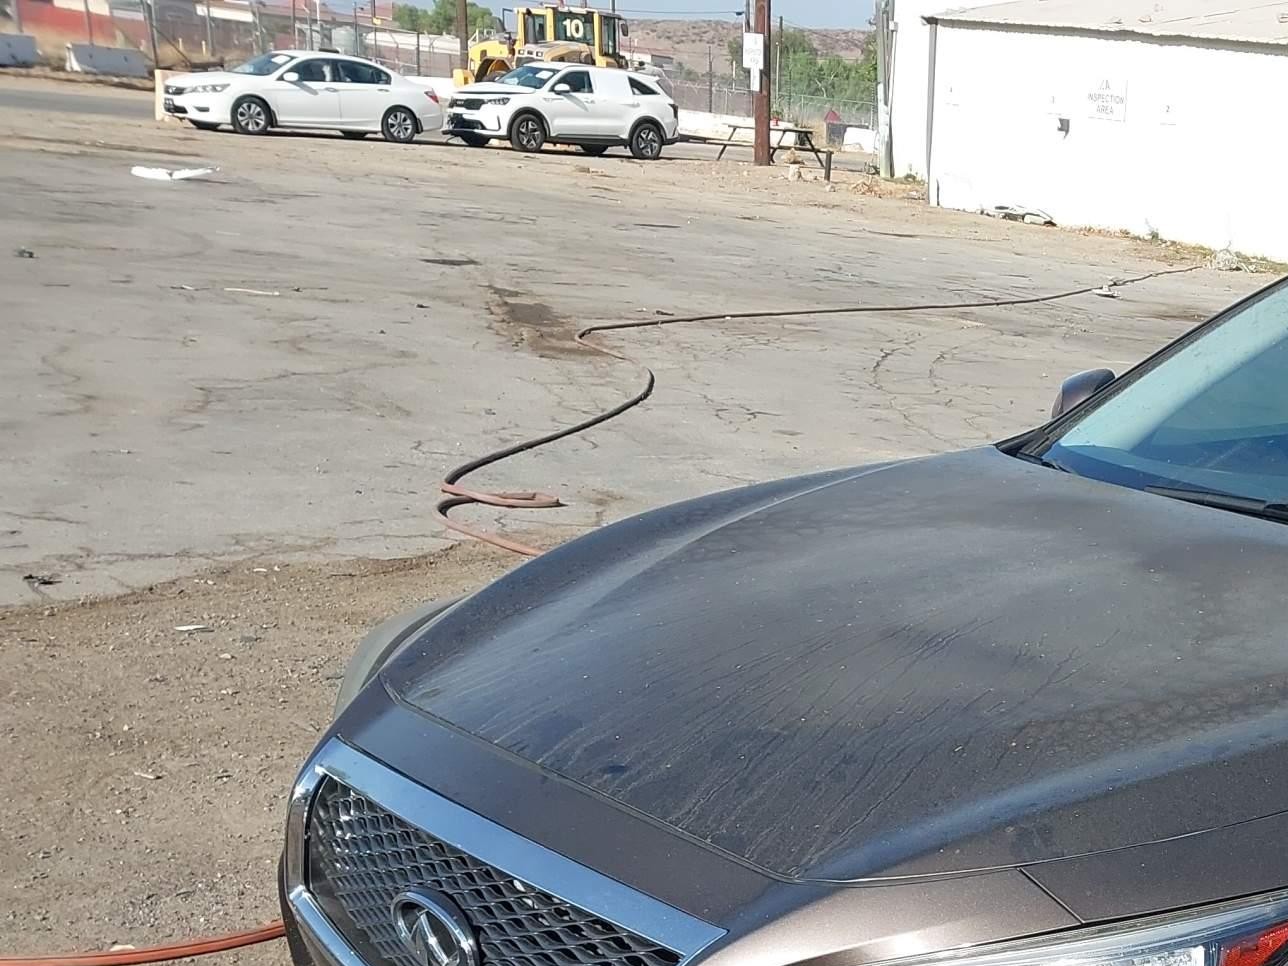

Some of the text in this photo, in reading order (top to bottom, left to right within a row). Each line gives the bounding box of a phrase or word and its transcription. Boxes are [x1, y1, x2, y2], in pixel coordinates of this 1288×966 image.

[562, 17, 584, 39] 10
[1087, 93, 1125, 105] INSPECTION
[1096, 104, 1114, 115] AREA
